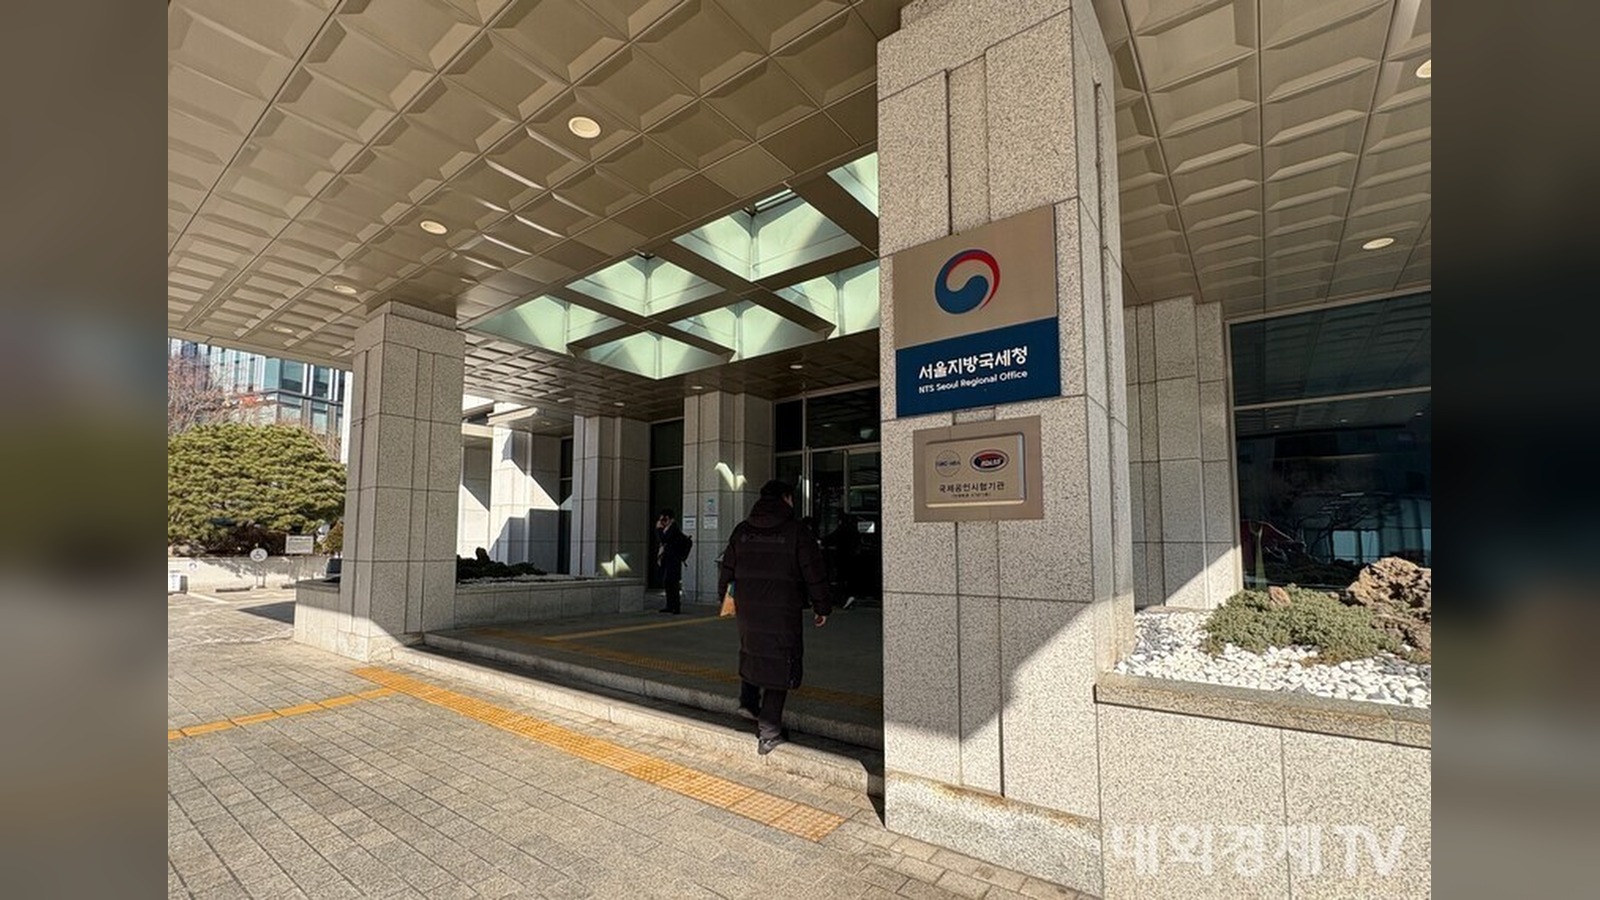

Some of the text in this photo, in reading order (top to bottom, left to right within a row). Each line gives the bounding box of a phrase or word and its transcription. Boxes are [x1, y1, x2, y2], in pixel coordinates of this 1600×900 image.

[918, 345, 1028, 380] 서울지방국세청
[918, 370, 1028, 394] NTS Seoul Regional Office
